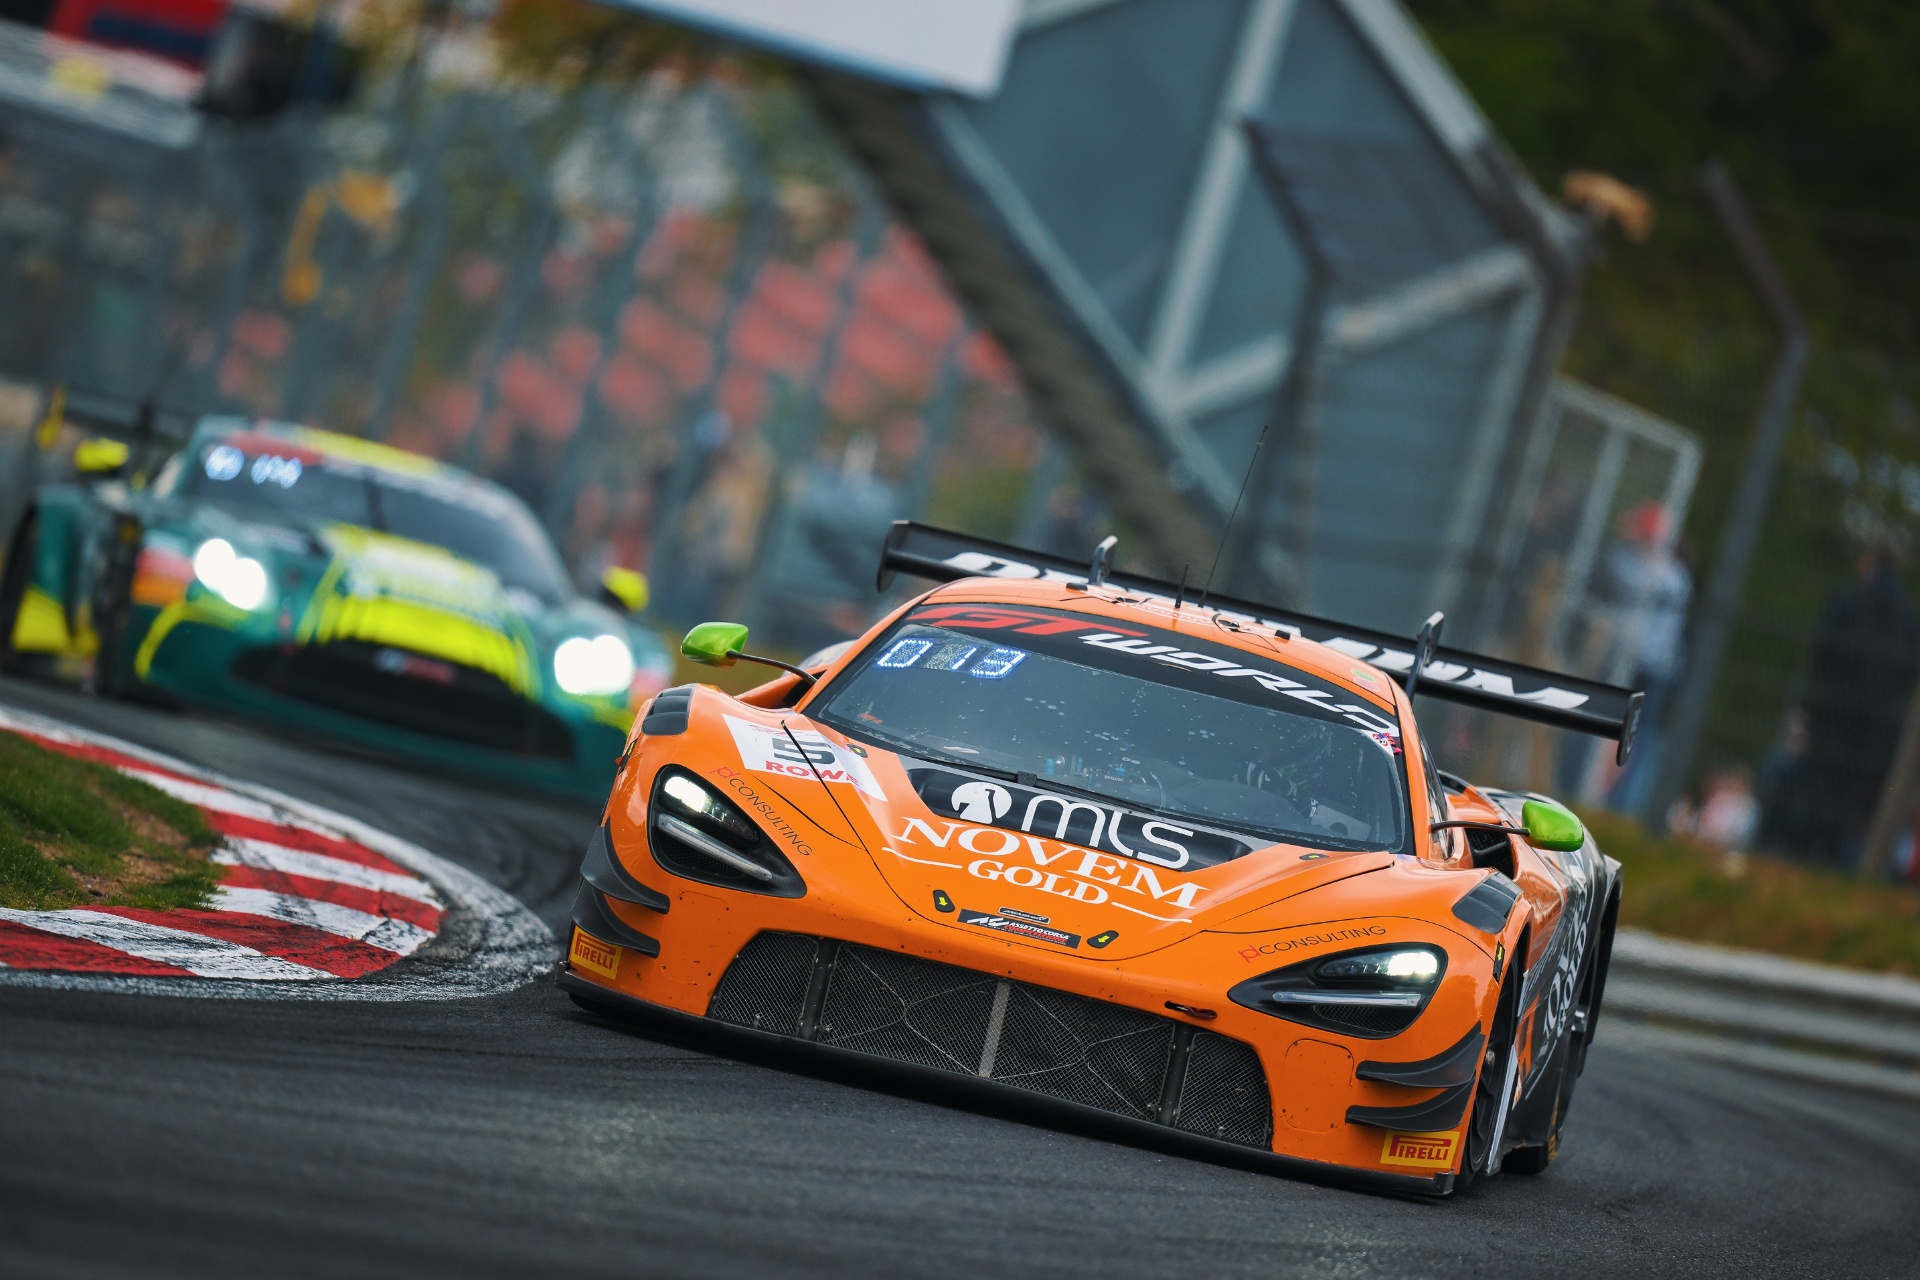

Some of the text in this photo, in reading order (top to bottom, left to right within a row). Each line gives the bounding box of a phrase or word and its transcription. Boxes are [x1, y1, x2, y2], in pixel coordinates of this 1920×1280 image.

[772, 737, 836, 765] 5
[889, 816, 1210, 910] NOVEM
[967, 859, 1109, 905] GOLD
[1009, 921, 1044, 934] ASSETTO
[1042, 929, 1071, 940] CORSA
[574, 931, 617, 970] PIRELLI
[1388, 1134, 1452, 1161] PIRELLI
